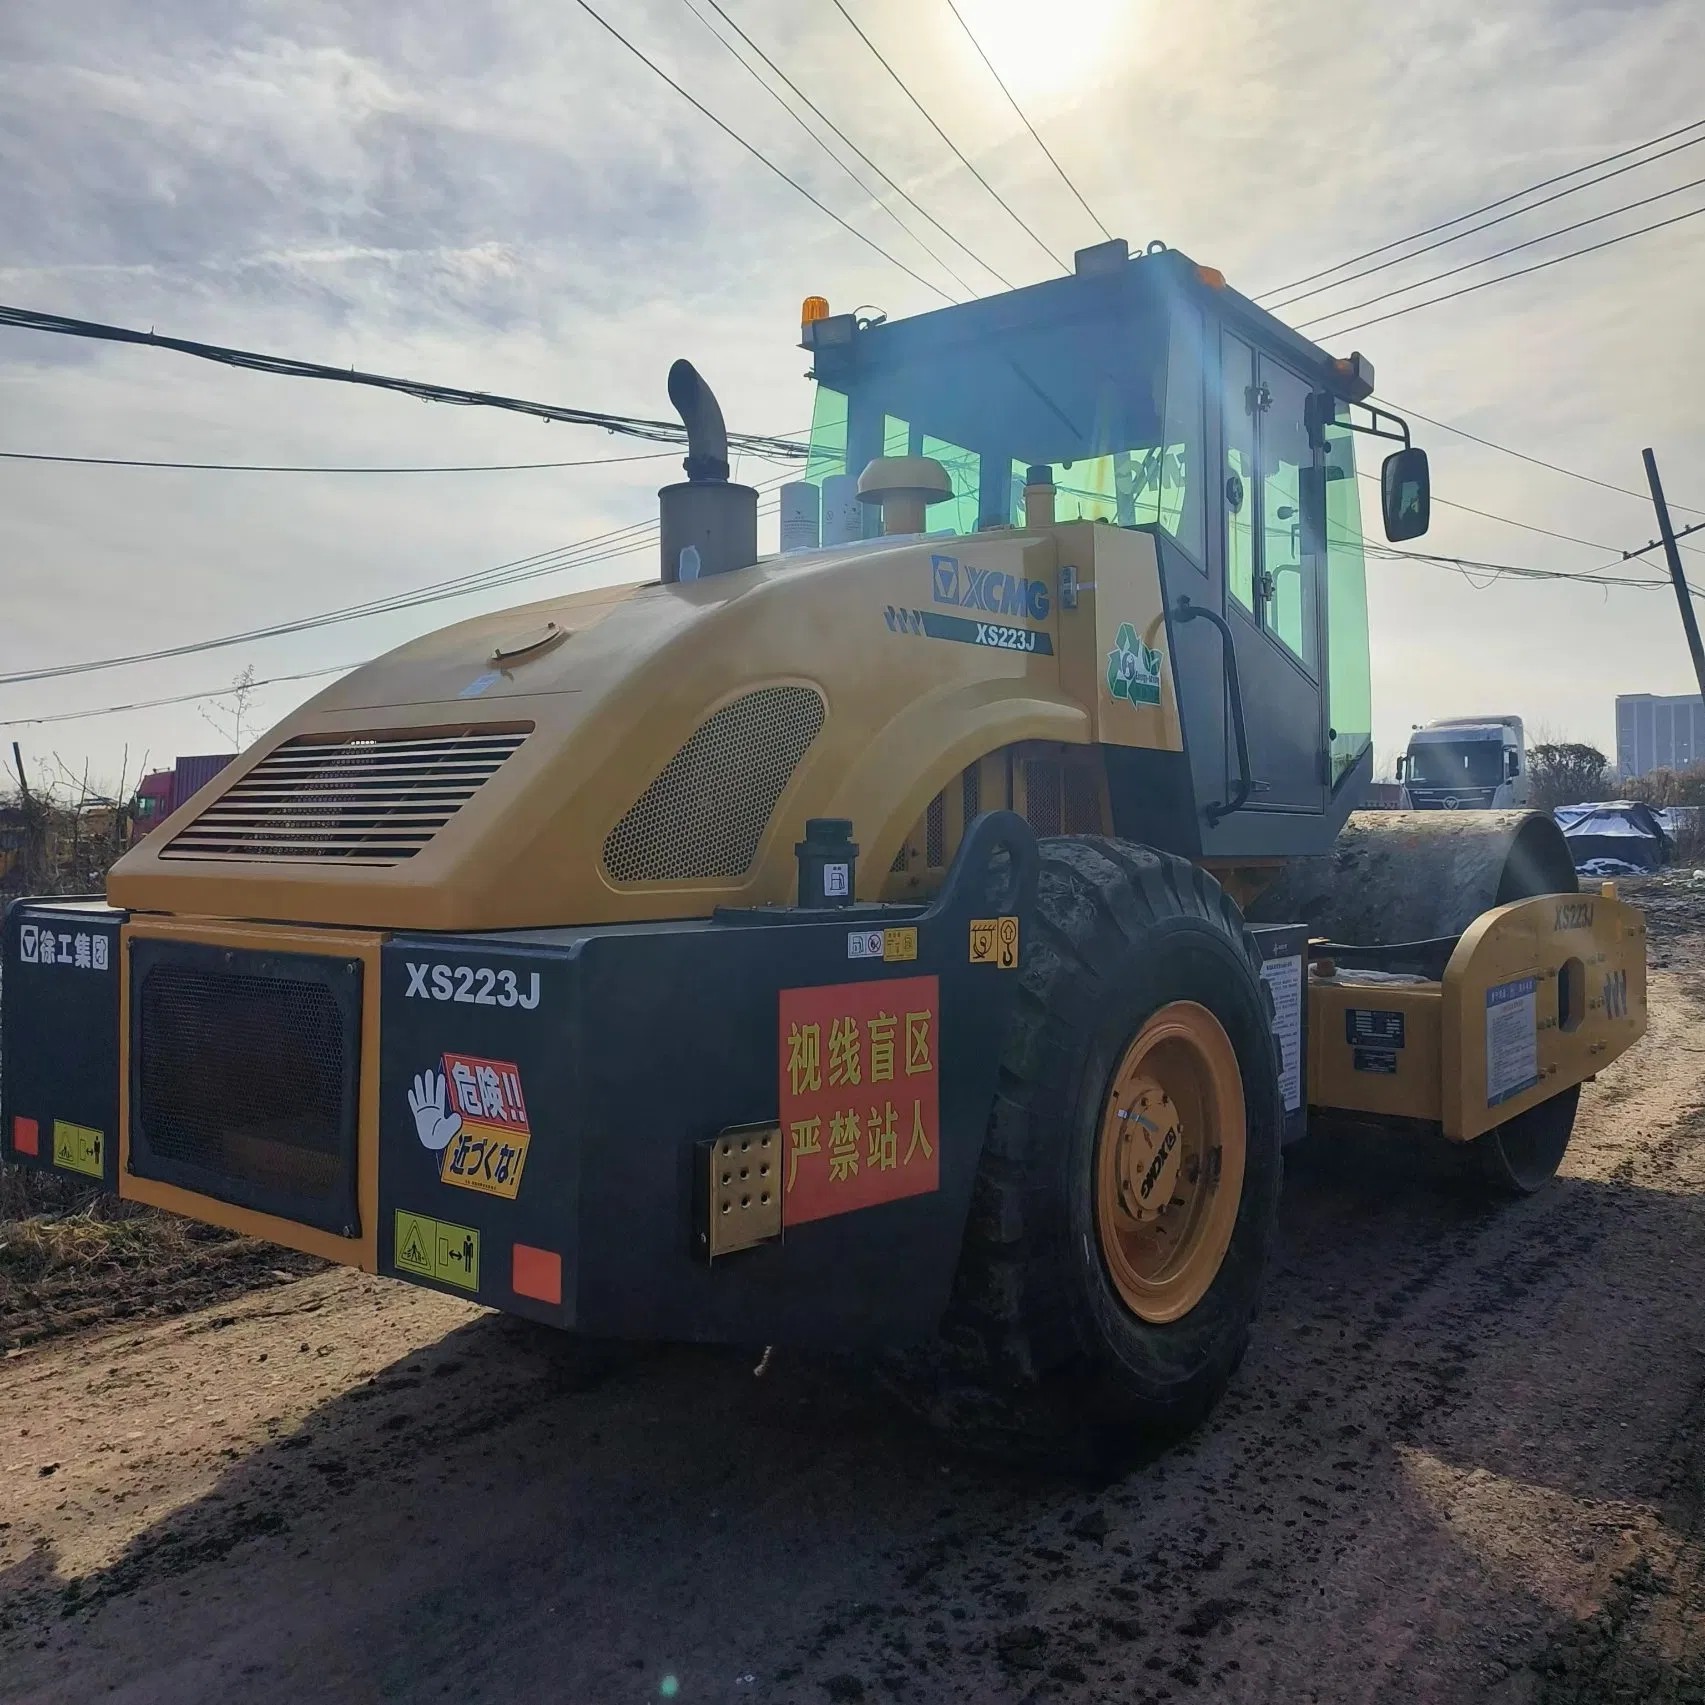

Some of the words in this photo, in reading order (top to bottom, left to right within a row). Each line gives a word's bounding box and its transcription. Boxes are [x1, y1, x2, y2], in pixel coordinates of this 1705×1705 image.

[960, 565, 1050, 620] XCMG
[975, 623, 1036, 651] XS223J
[1555, 902, 1594, 931] XS223J
[40, 930, 108, 970] 徐工集团
[405, 962, 540, 1009] XS223J
[787, 1009, 933, 1095] 视线盲区
[787, 1100, 933, 1192] 严禁站人
